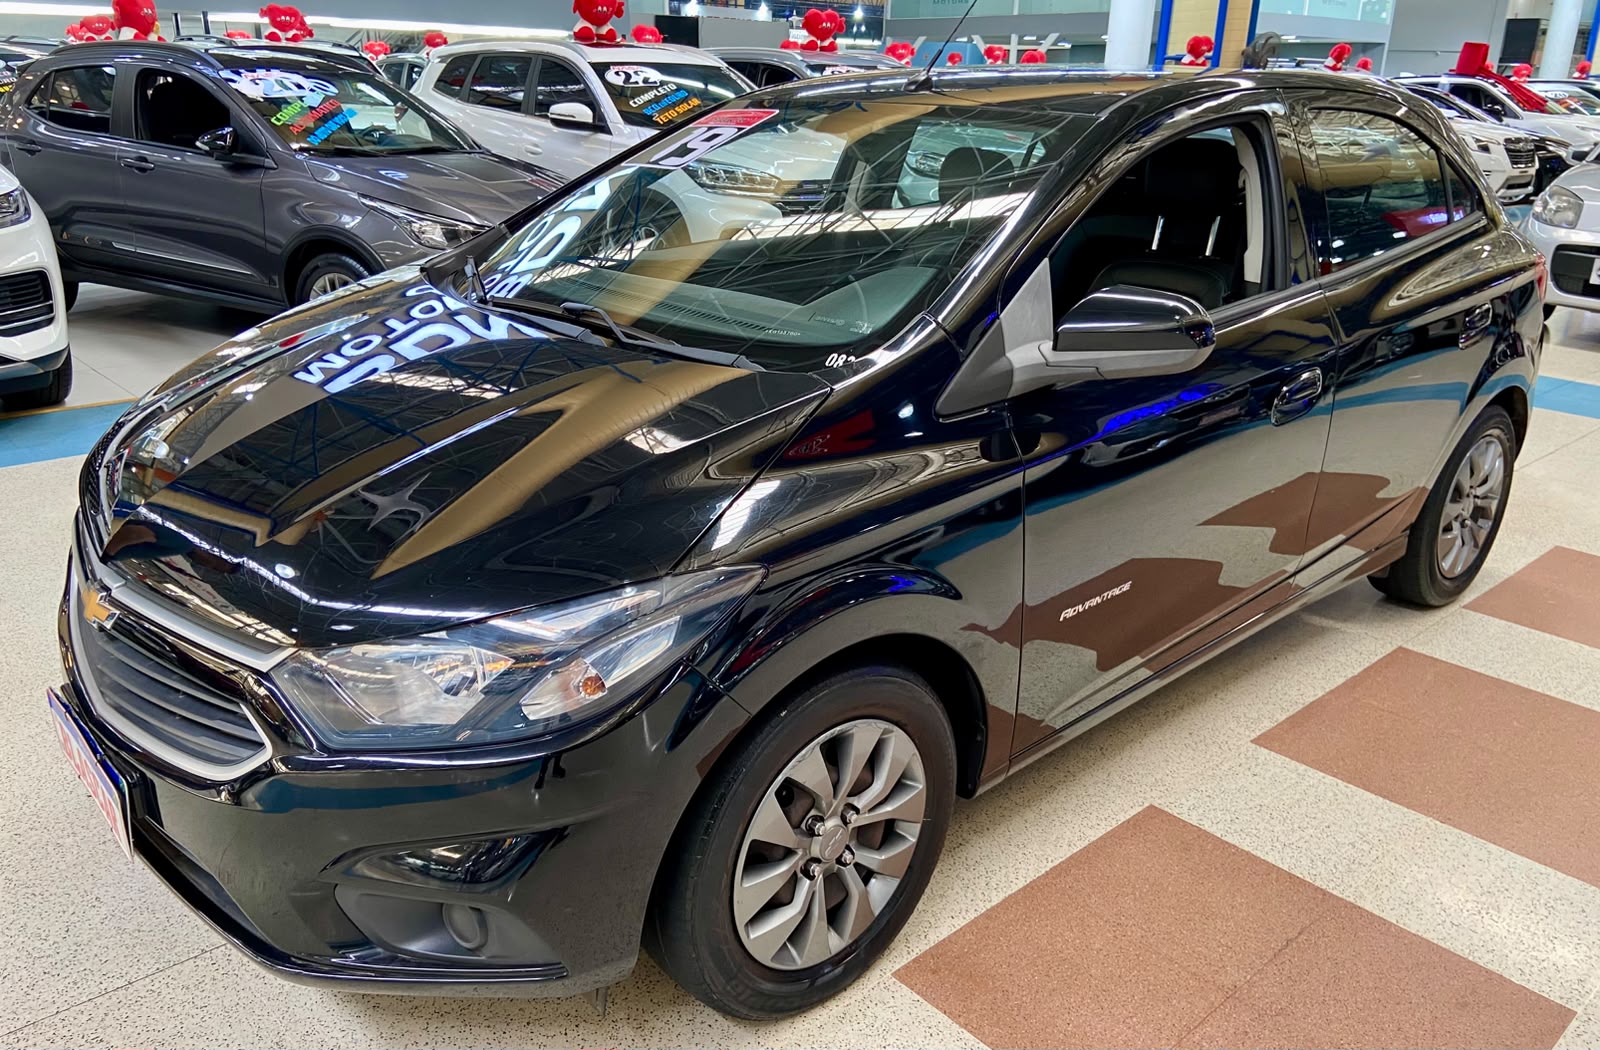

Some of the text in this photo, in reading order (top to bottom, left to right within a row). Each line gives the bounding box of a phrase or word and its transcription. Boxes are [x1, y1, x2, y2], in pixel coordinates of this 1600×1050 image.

[614, 70, 659, 86] 22
[270, 91, 326, 127] COMPL
[629, 83, 678, 108] COMPLETO
[655, 97, 702, 125] TETO SOLAR
[650, 126, 739, 167] 19
[1059, 580, 1133, 622] ADVANTAGE
